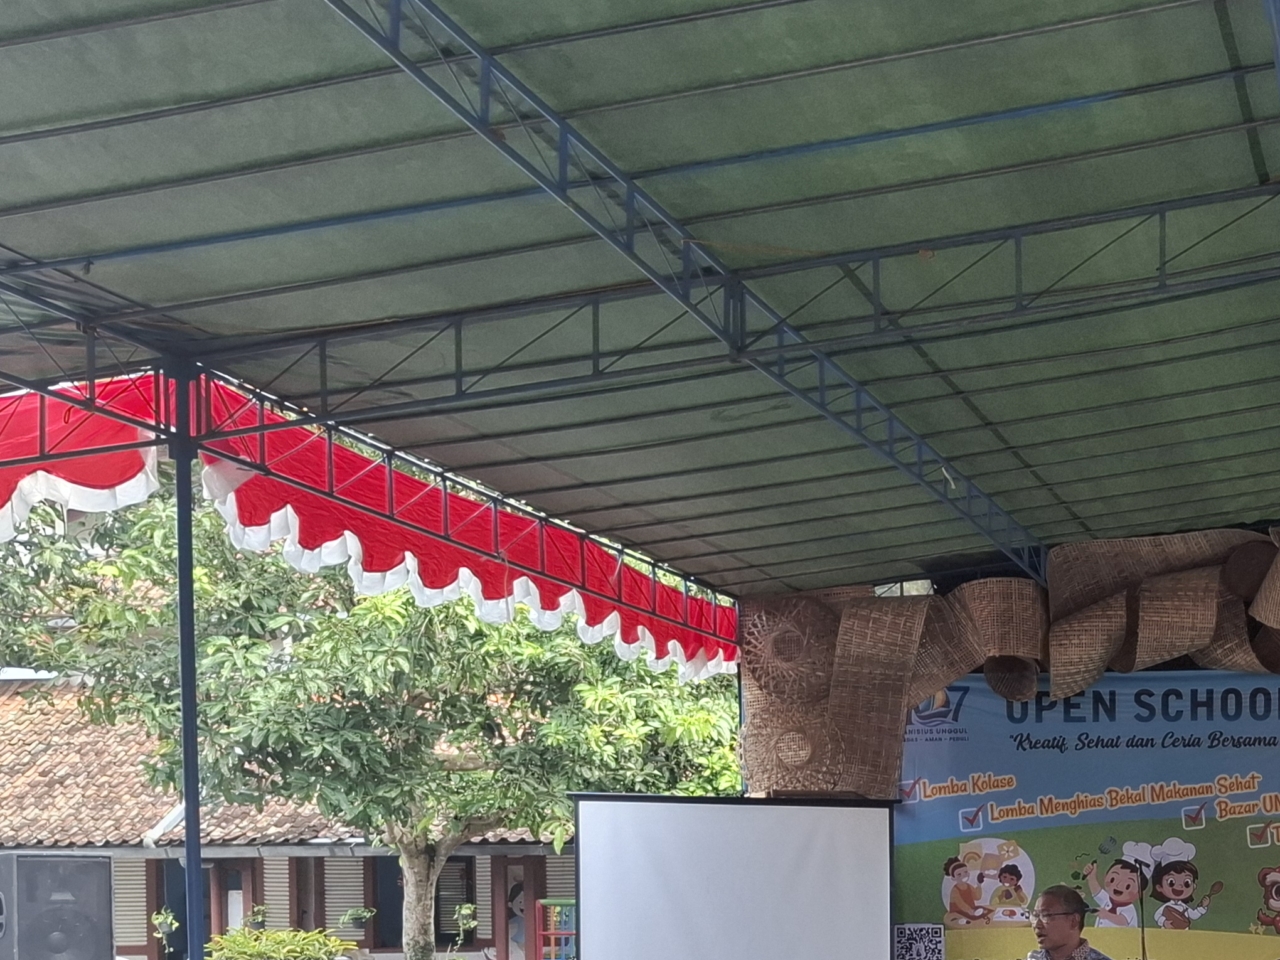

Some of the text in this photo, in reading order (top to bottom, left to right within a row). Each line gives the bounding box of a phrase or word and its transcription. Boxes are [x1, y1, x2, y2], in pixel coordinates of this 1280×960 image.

[1005, 689, 1117, 724] OPEN
[1075, 731, 1121, 750] Sehat
[1126, 734, 1157, 750] dan
[1161, 731, 1204, 749] Ceria
[1207, 730, 1279, 749] Bersama
[922, 773, 1015, 798] Lomba Kolase
[989, 774, 1261, 821] Lomba Menghias Bekal Makanan Sehat
[1216, 799, 1259, 819] Bazar
